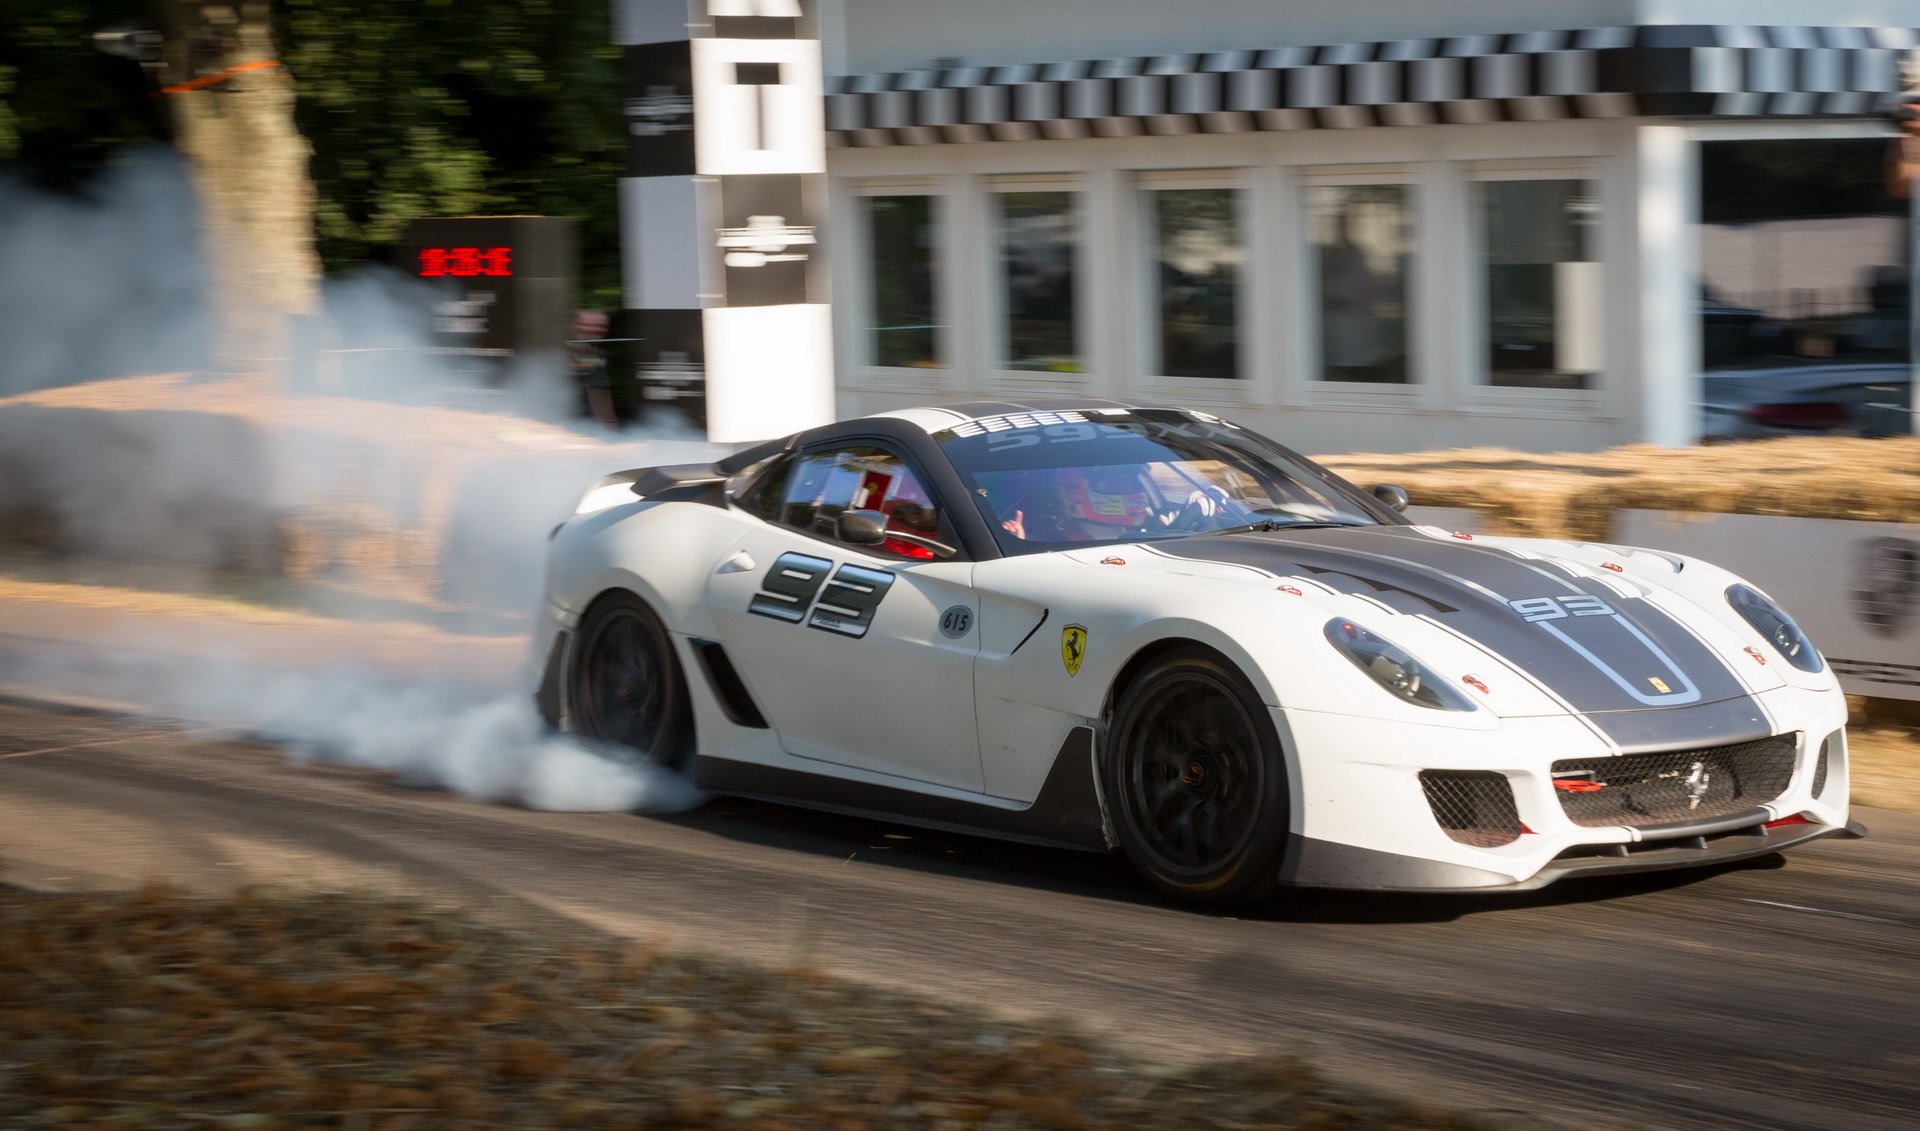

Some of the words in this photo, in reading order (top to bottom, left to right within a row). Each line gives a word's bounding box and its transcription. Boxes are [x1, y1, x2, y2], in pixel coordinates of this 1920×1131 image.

[747, 550, 896, 640] 93
[1507, 594, 1616, 623] 93
[943, 612, 969, 632] 615
